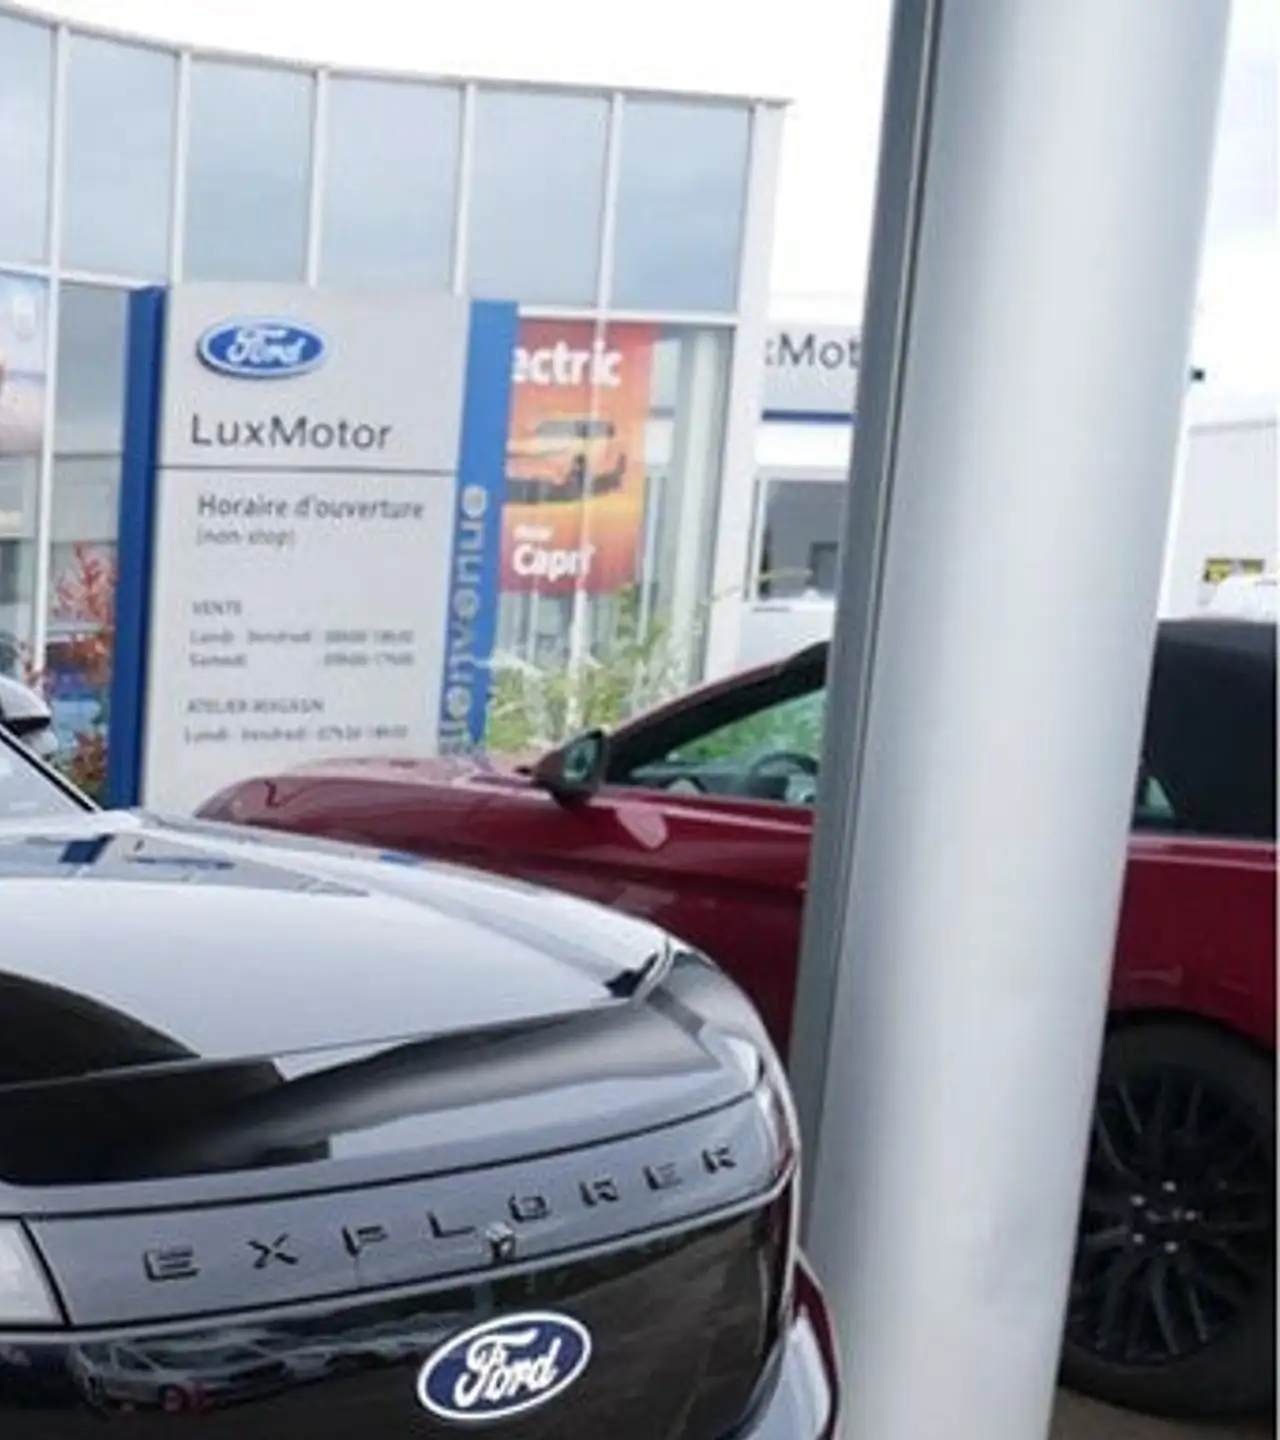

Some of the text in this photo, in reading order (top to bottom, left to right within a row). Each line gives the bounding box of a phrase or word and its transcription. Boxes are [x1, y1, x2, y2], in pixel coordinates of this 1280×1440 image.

[191, 413, 392, 450] LuxMotor
[197, 494, 287, 518] Horaire
[143, 1145, 737, 1282] EXPLORER
[452, 1328, 562, 1409] Ford
